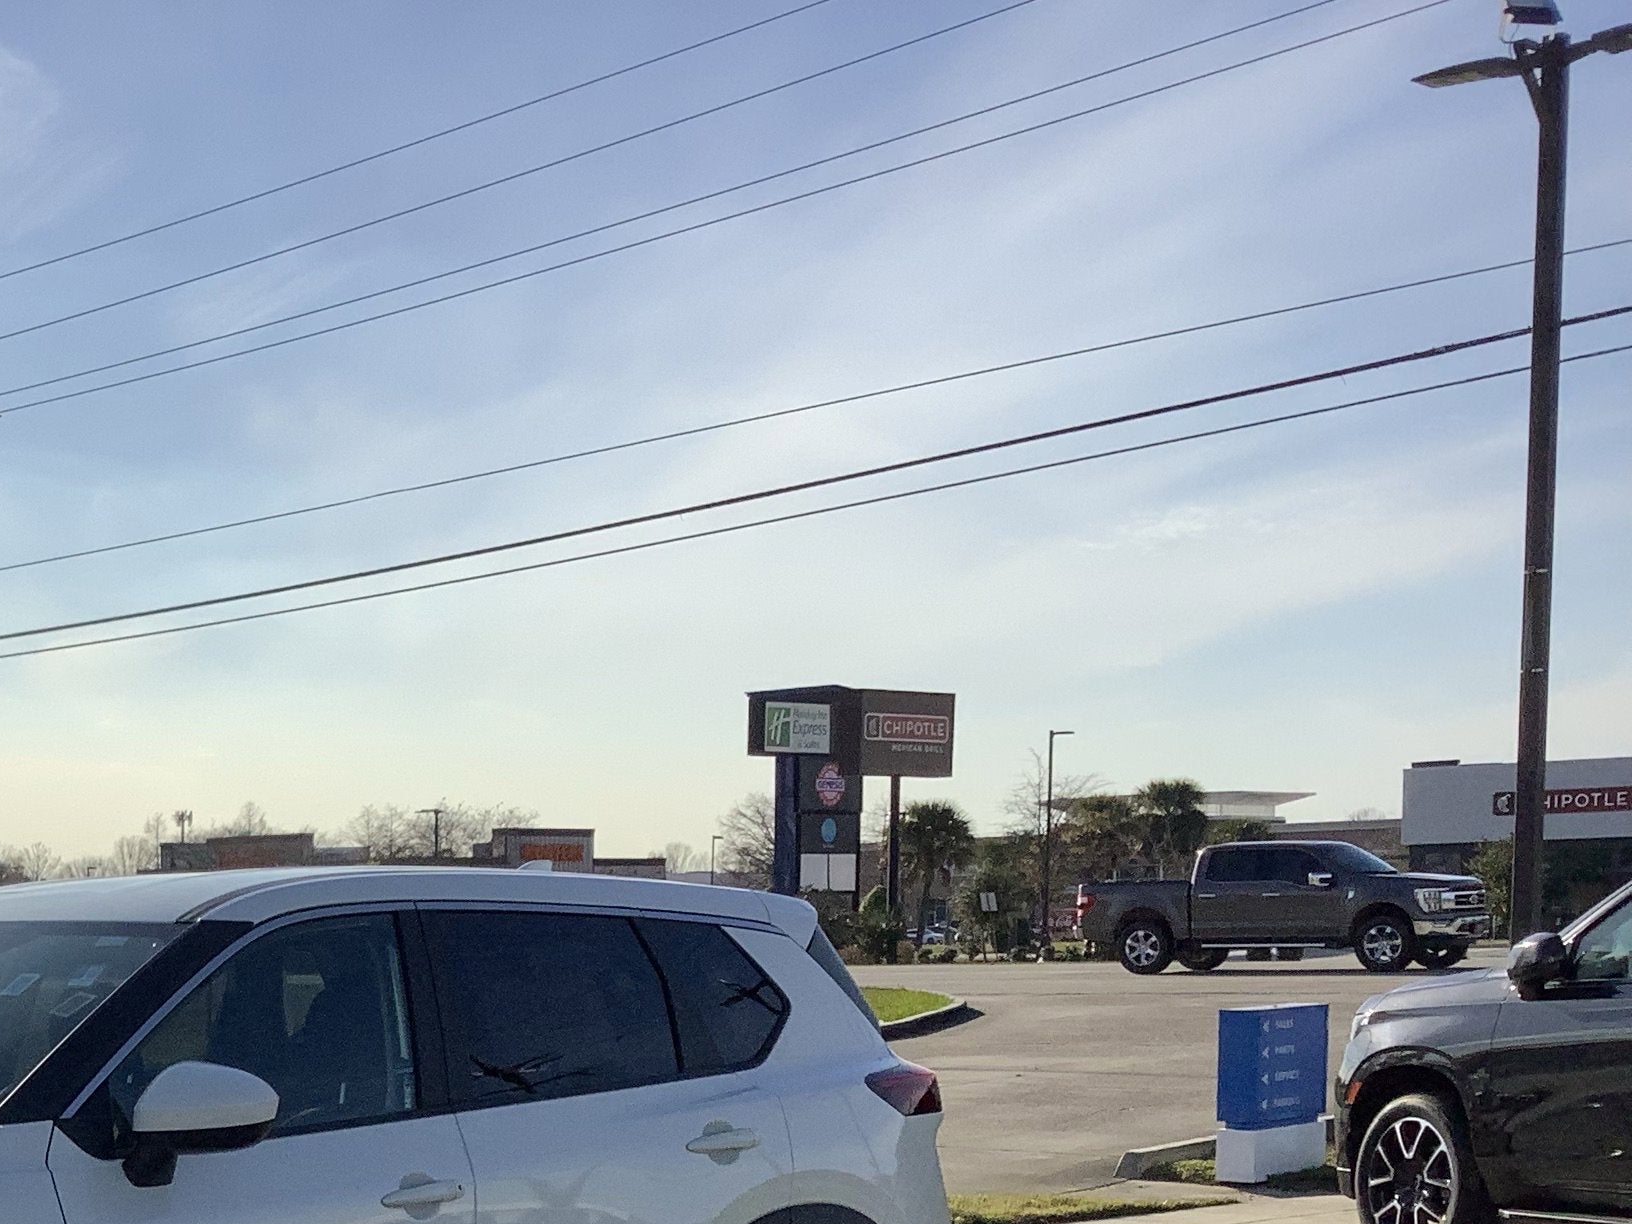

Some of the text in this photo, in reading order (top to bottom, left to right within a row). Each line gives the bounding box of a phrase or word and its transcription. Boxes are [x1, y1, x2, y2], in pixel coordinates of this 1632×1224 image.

[792, 720, 827, 737] Express
[883, 720, 945, 737] CHIPOTLE
[1544, 791, 1628, 809] HIPOTLE
